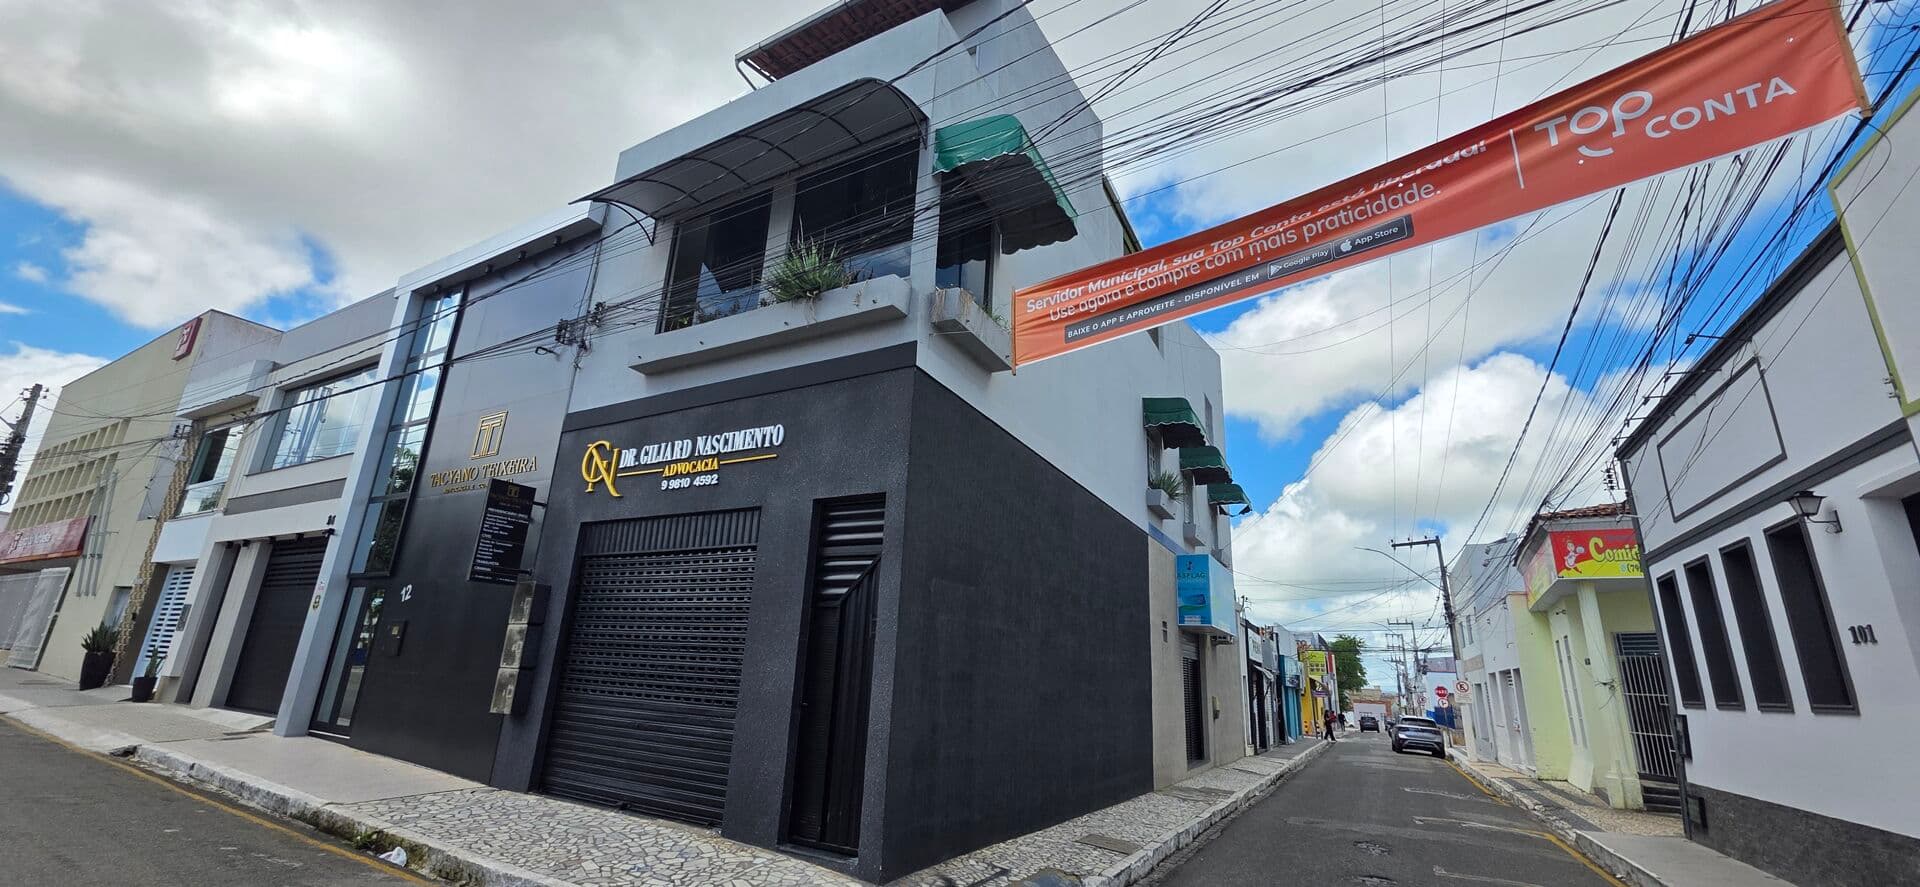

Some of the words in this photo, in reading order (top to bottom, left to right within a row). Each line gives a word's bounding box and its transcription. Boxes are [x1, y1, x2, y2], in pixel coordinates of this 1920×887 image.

[1645, 76, 1797, 140] CONTA
[1354, 234, 1374, 246] App
[1375, 226, 1399, 239] Store
[1026, 286, 1085, 313] Servidor
[1088, 259, 1169, 293] Municipal,
[1172, 249, 1205, 266] sua
[1210, 236, 1244, 253] Top
[1250, 211, 1312, 238] Conta
[1050, 305, 1076, 321] Use
[1079, 290, 1121, 312] agora
[1125, 285, 1135, 296] e
[1138, 264, 1201, 292] compre
[1205, 248, 1244, 270] com
[1248, 228, 1298, 256] mais
[1302, 182, 1441, 242] praticidade.
[1283, 255, 1311, 269] Google
[1312, 249, 1329, 261] Play
[1068, 325, 1091, 338] BAIXE
[1101, 317, 1117, 328] APP
[1126, 299, 1176, 320] APROVEITE
[1184, 279, 1242, 302] DISPONÍVEL
[1245, 272, 1260, 283] EM
[618, 448, 638, 469] DR.
[639, 439, 693, 465] GILIARD
[695, 423, 785, 457] NASCIMENTO
[431, 464, 480, 487] TACYANO
[482, 456, 537, 479] TEIXEIRA
[662, 457, 719, 478] ADVOCACIA
[669, 477, 690, 489] 9810
[692, 474, 719, 487] 4592
[400, 584, 413, 602] 12
[1848, 623, 1878, 646] 101
